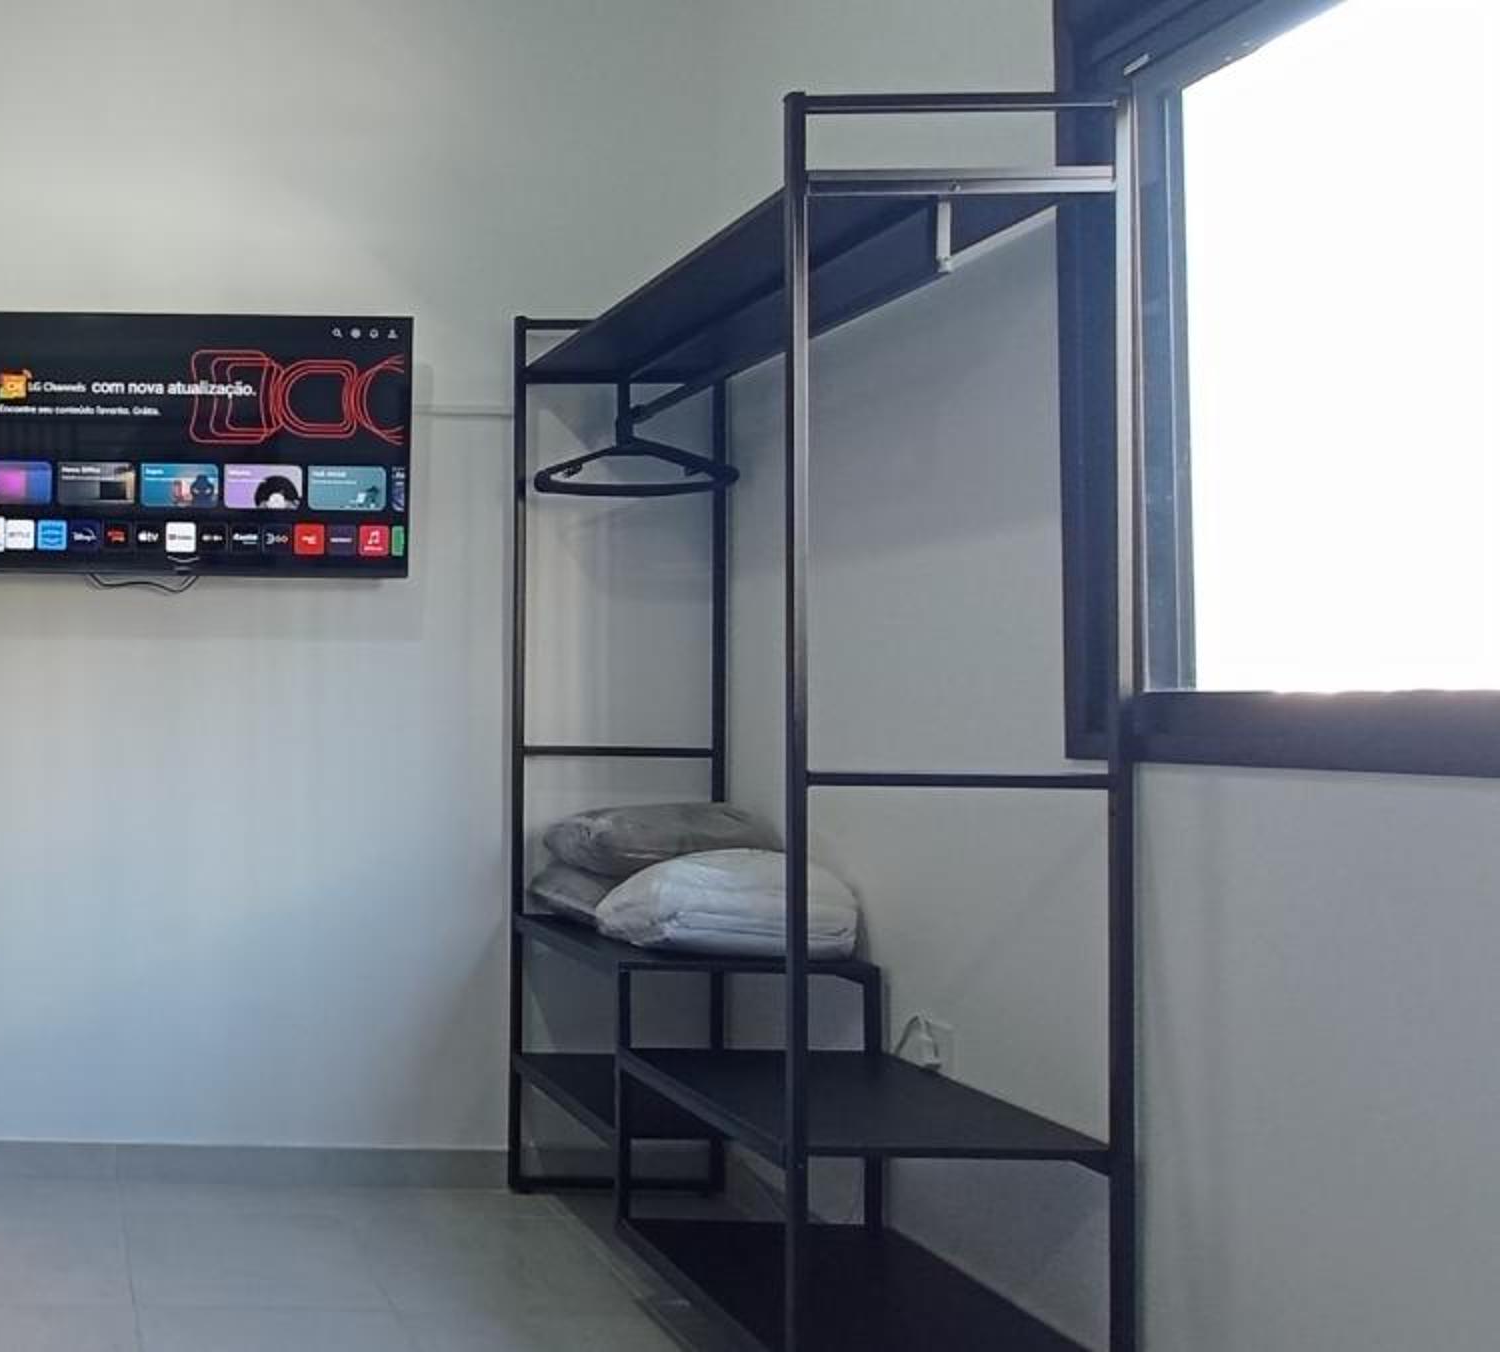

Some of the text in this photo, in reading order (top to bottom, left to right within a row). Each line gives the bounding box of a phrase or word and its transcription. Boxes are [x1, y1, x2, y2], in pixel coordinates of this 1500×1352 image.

[91, 382, 125, 394] com
[128, 382, 164, 395] nova
[167, 380, 257, 398] atualização.
